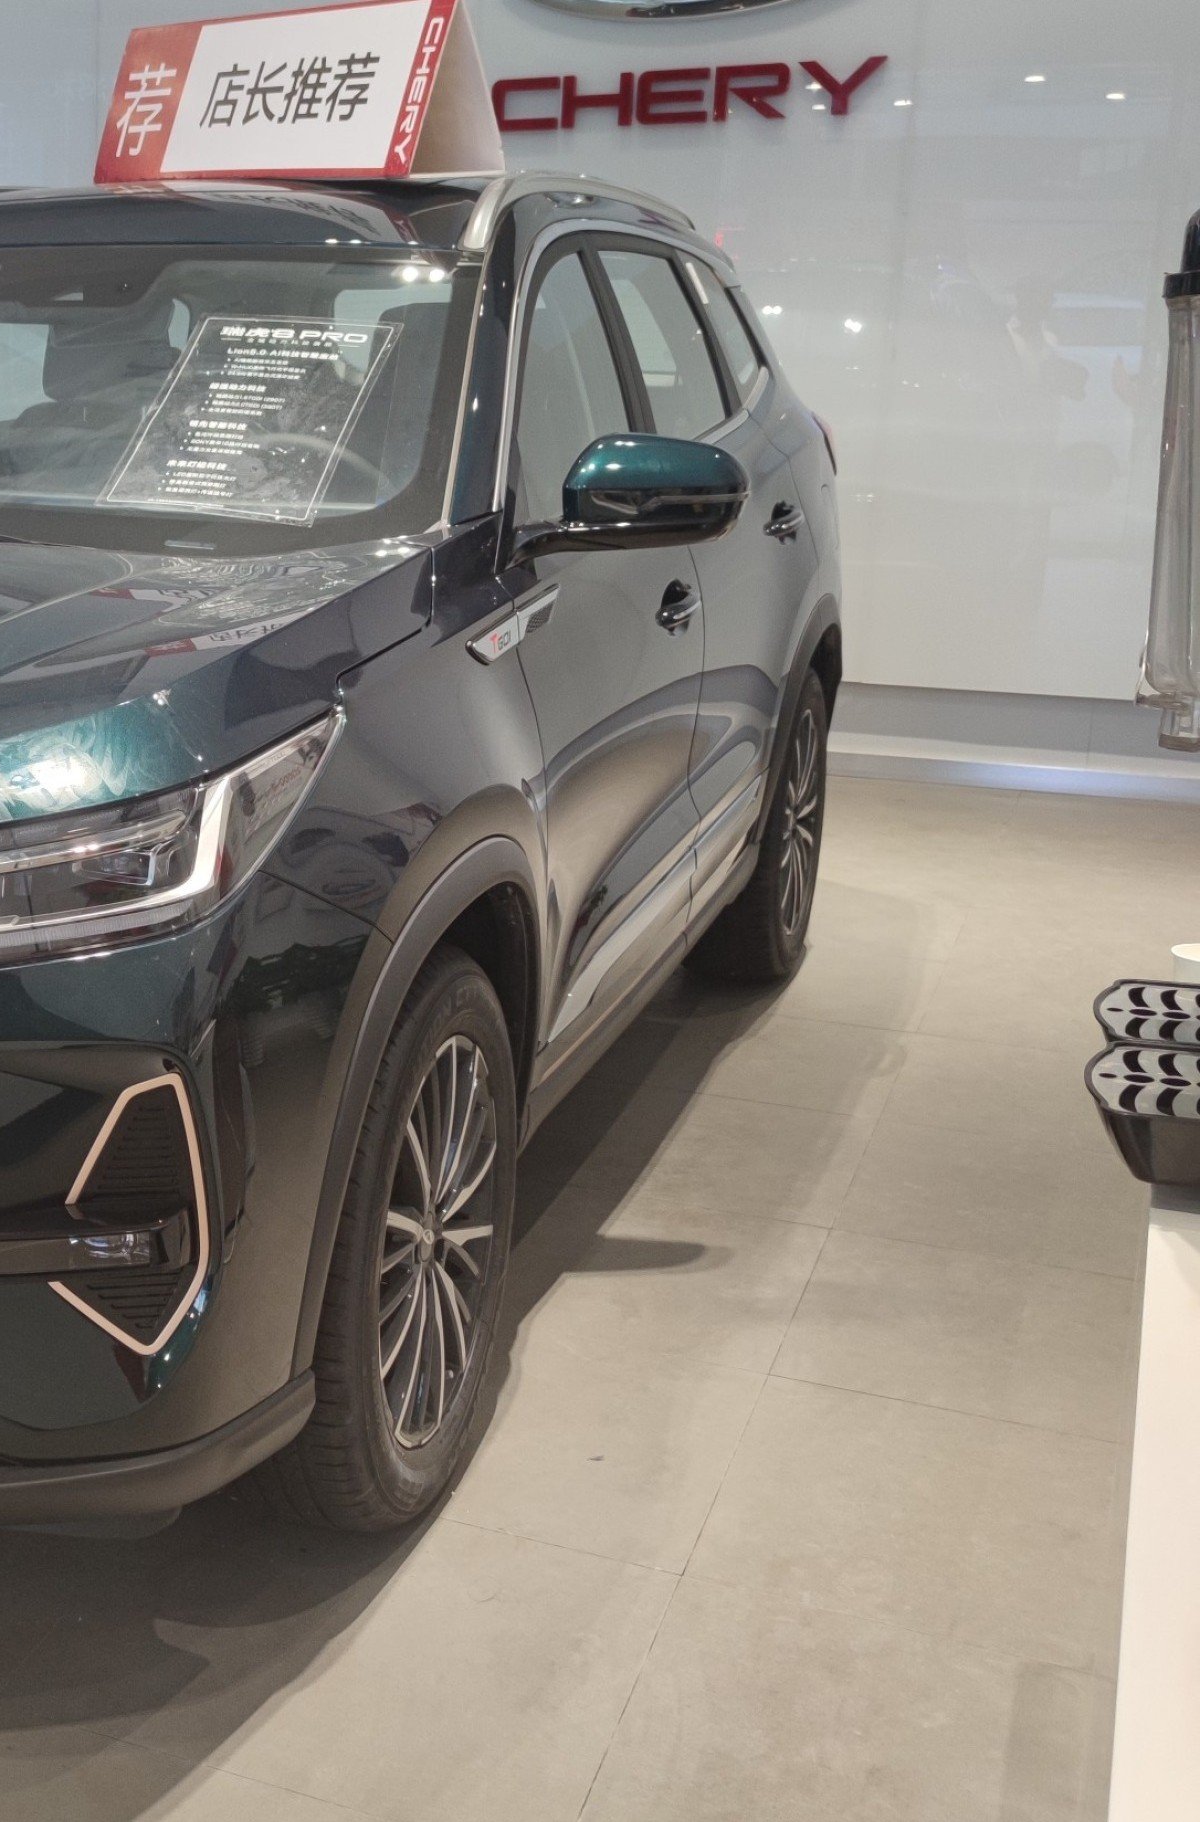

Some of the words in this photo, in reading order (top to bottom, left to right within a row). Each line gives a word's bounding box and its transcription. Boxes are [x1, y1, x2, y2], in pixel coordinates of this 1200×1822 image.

[116, 62, 177, 158] 荐
[200, 51, 380, 128] 店长推荐
[394, 17, 444, 164] CHERY
[491, 55, 888, 132] CHERY
[299, 329, 368, 343] PRO
